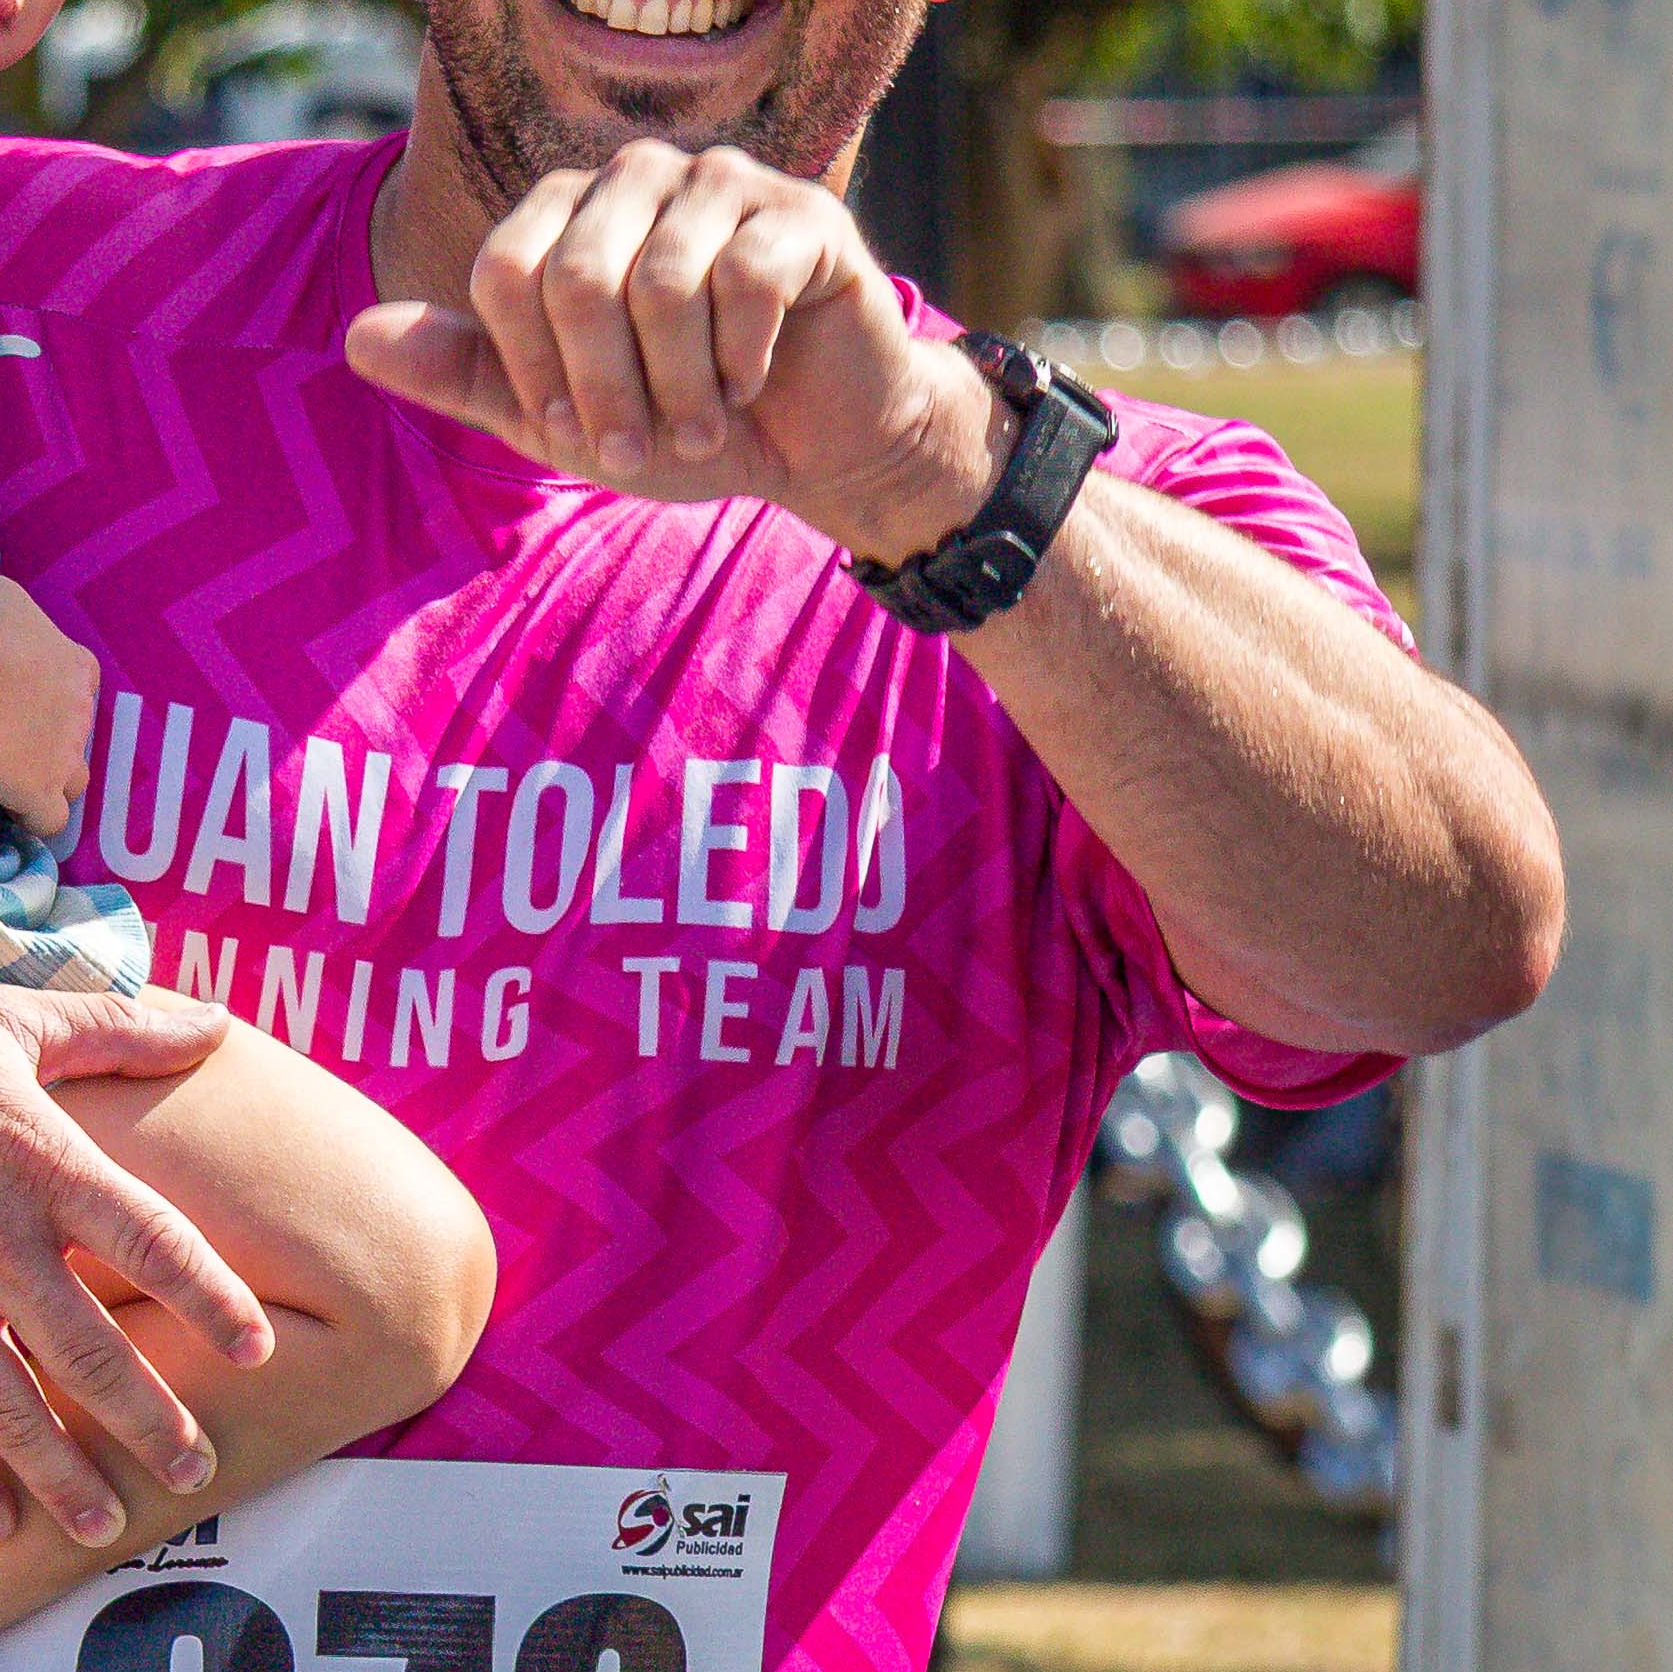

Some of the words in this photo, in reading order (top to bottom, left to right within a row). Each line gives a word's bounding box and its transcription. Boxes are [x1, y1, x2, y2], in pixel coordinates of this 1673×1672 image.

[436, 752, 908, 938] TOLEDO
[144, 919, 533, 1070] NNING
[622, 956, 907, 1071] TEAM
[675, 1540, 744, 1556] Publicidad
[682, 1494, 752, 1538] sai
